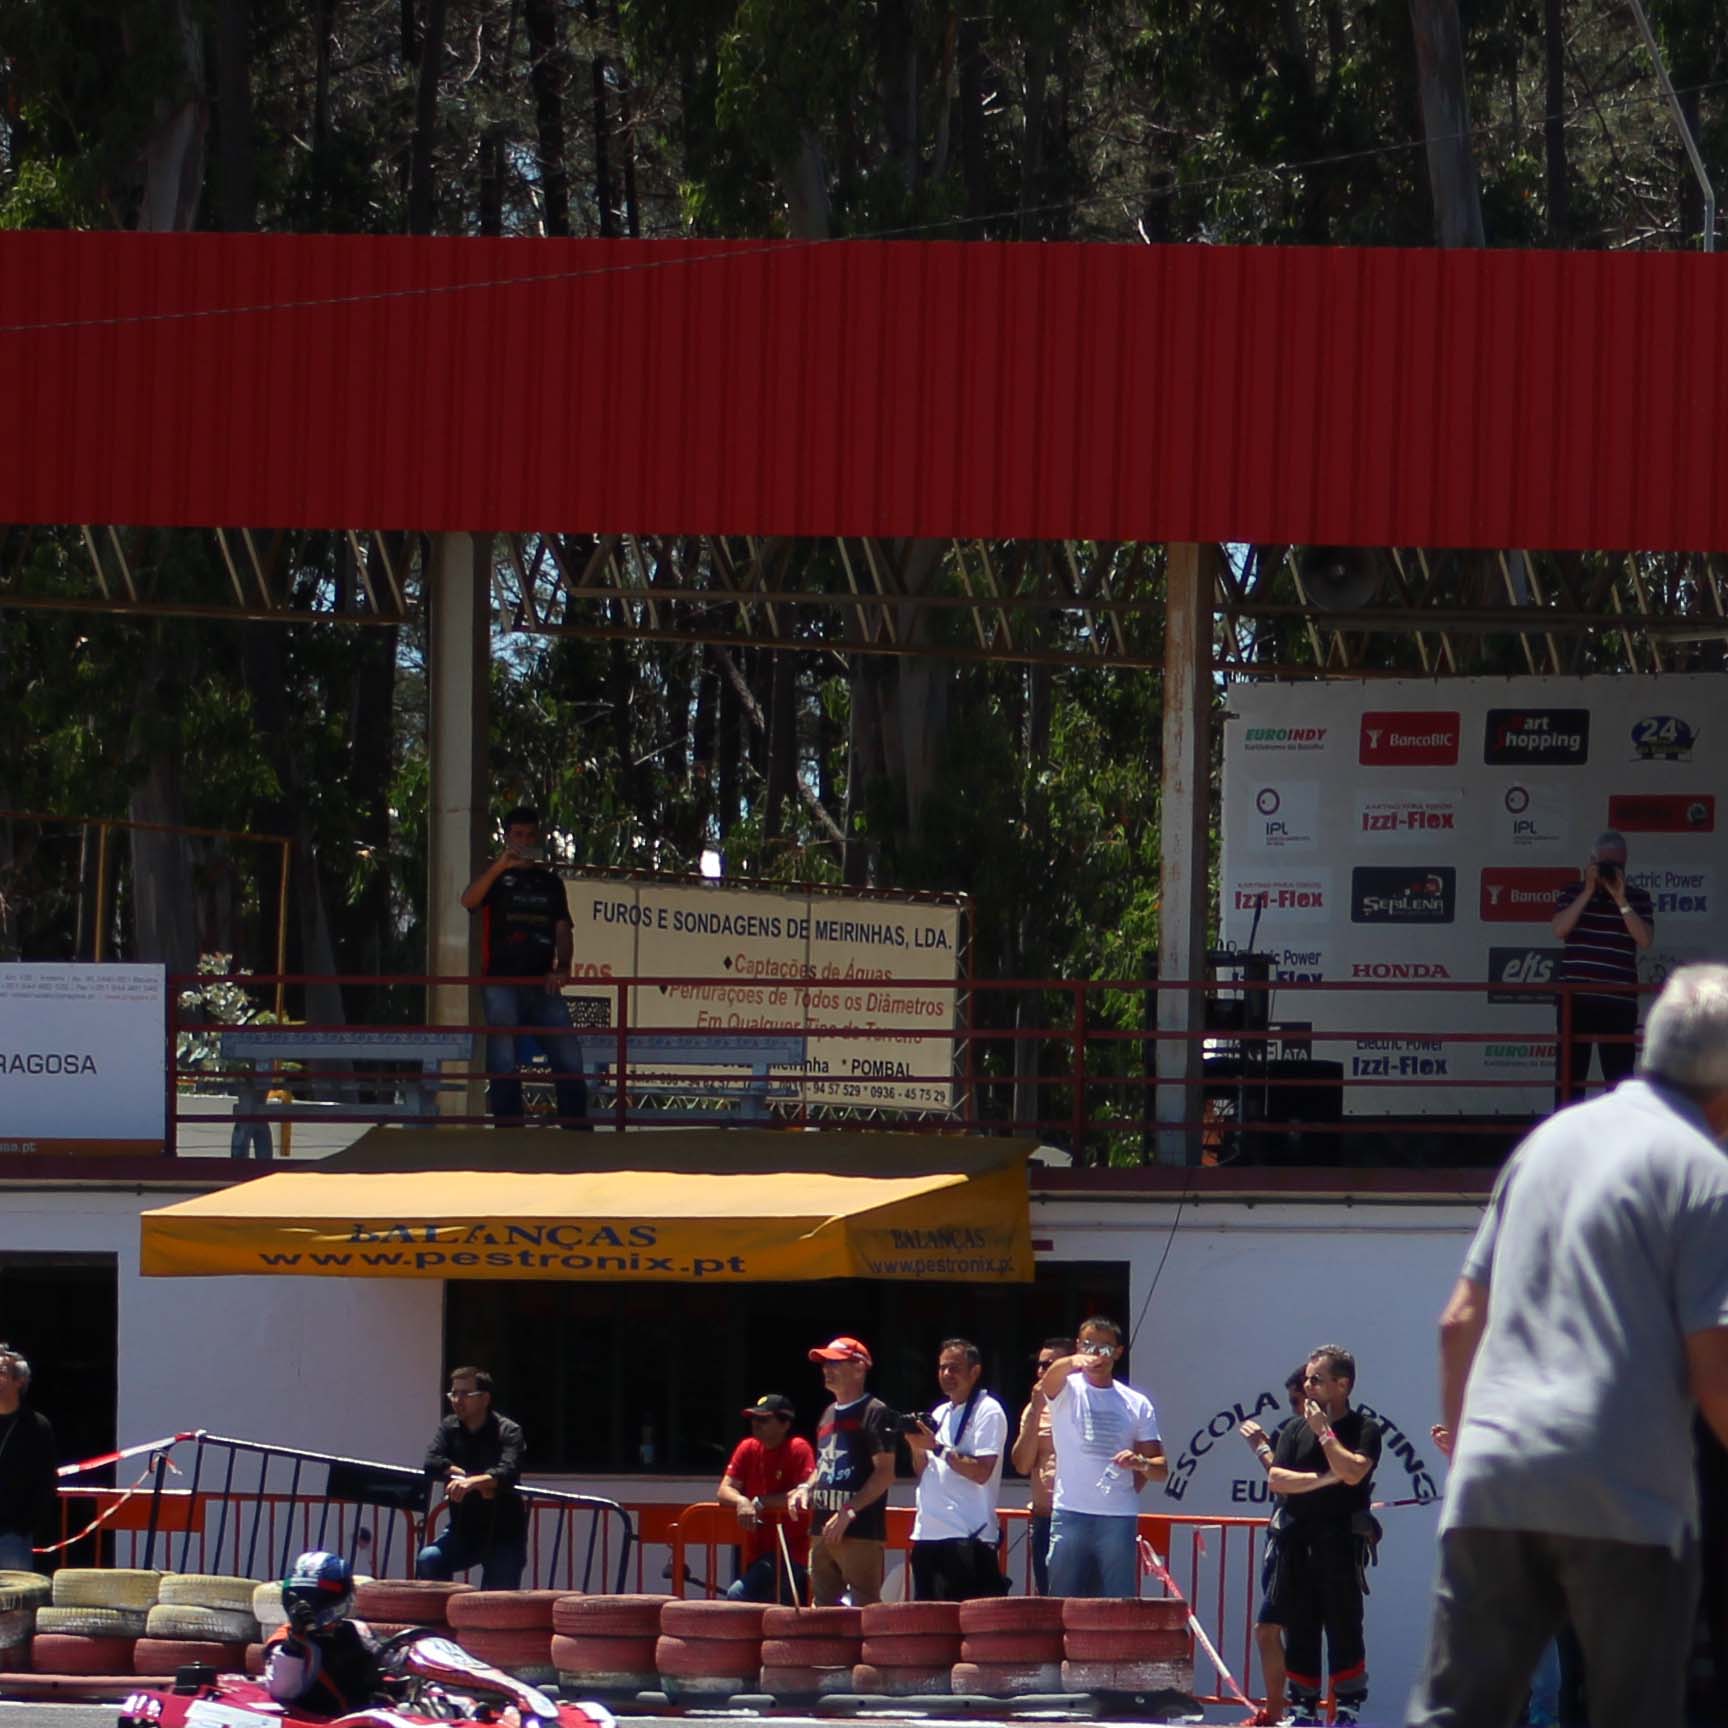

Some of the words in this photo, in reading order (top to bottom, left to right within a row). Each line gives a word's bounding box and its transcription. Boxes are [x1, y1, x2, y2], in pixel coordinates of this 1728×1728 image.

[1245, 728, 1327, 741] EUROINDY
[1389, 732, 1453, 747] BancoBIC
[1640, 719, 1678, 742] 24
[1265, 822, 1288, 835] IPL
[1513, 819, 1536, 834] IPL
[1626, 871, 1662, 889] ectric
[1665, 872, 1704, 889] Power
[593, 900, 652, 927] FUROS
[657, 909, 669, 929] E
[673, 910, 781, 938] SONDAGENS
[786, 918, 810, 940] DE
[815, 920, 909, 949] MEIRINHAS,
[914, 928, 952, 949] LDA.
[1283, 950, 1322, 966] Power
[1351, 964, 1450, 978] HONDA
[768, 988, 787, 1005] de
[793, 987, 833, 1010] Todos
[844, 995, 861, 1012] os
[866, 988, 945, 1016] Diâmetros
[851, 1060, 914, 1077] POMBAL
[1353, 1056, 1449, 1076] Izzi-Flex
[260, 1250, 747, 1277] www.pestronix.pt
[1164, 1391, 1281, 1502] ESCOLA
[1357, 1403, 1437, 1505] RTING
